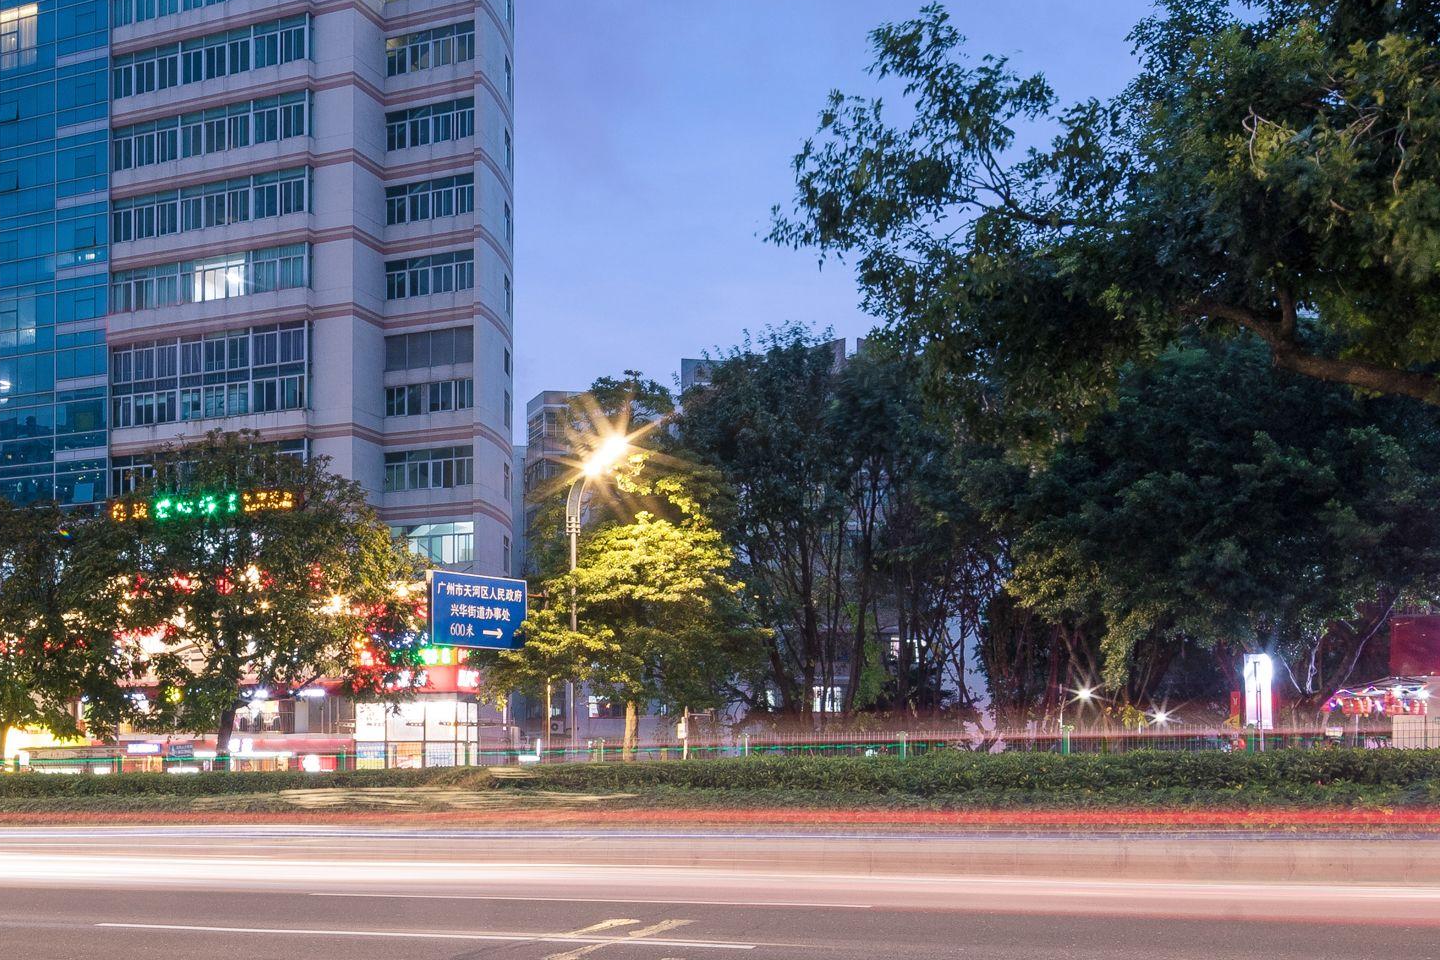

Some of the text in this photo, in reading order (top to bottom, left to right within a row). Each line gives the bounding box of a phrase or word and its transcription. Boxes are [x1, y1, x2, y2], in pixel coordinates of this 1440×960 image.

[438, 581, 522, 602] 广州市天河区人民政府
[450, 604, 510, 621] 兴华街道办事处
[450, 624, 475, 638] 600米
